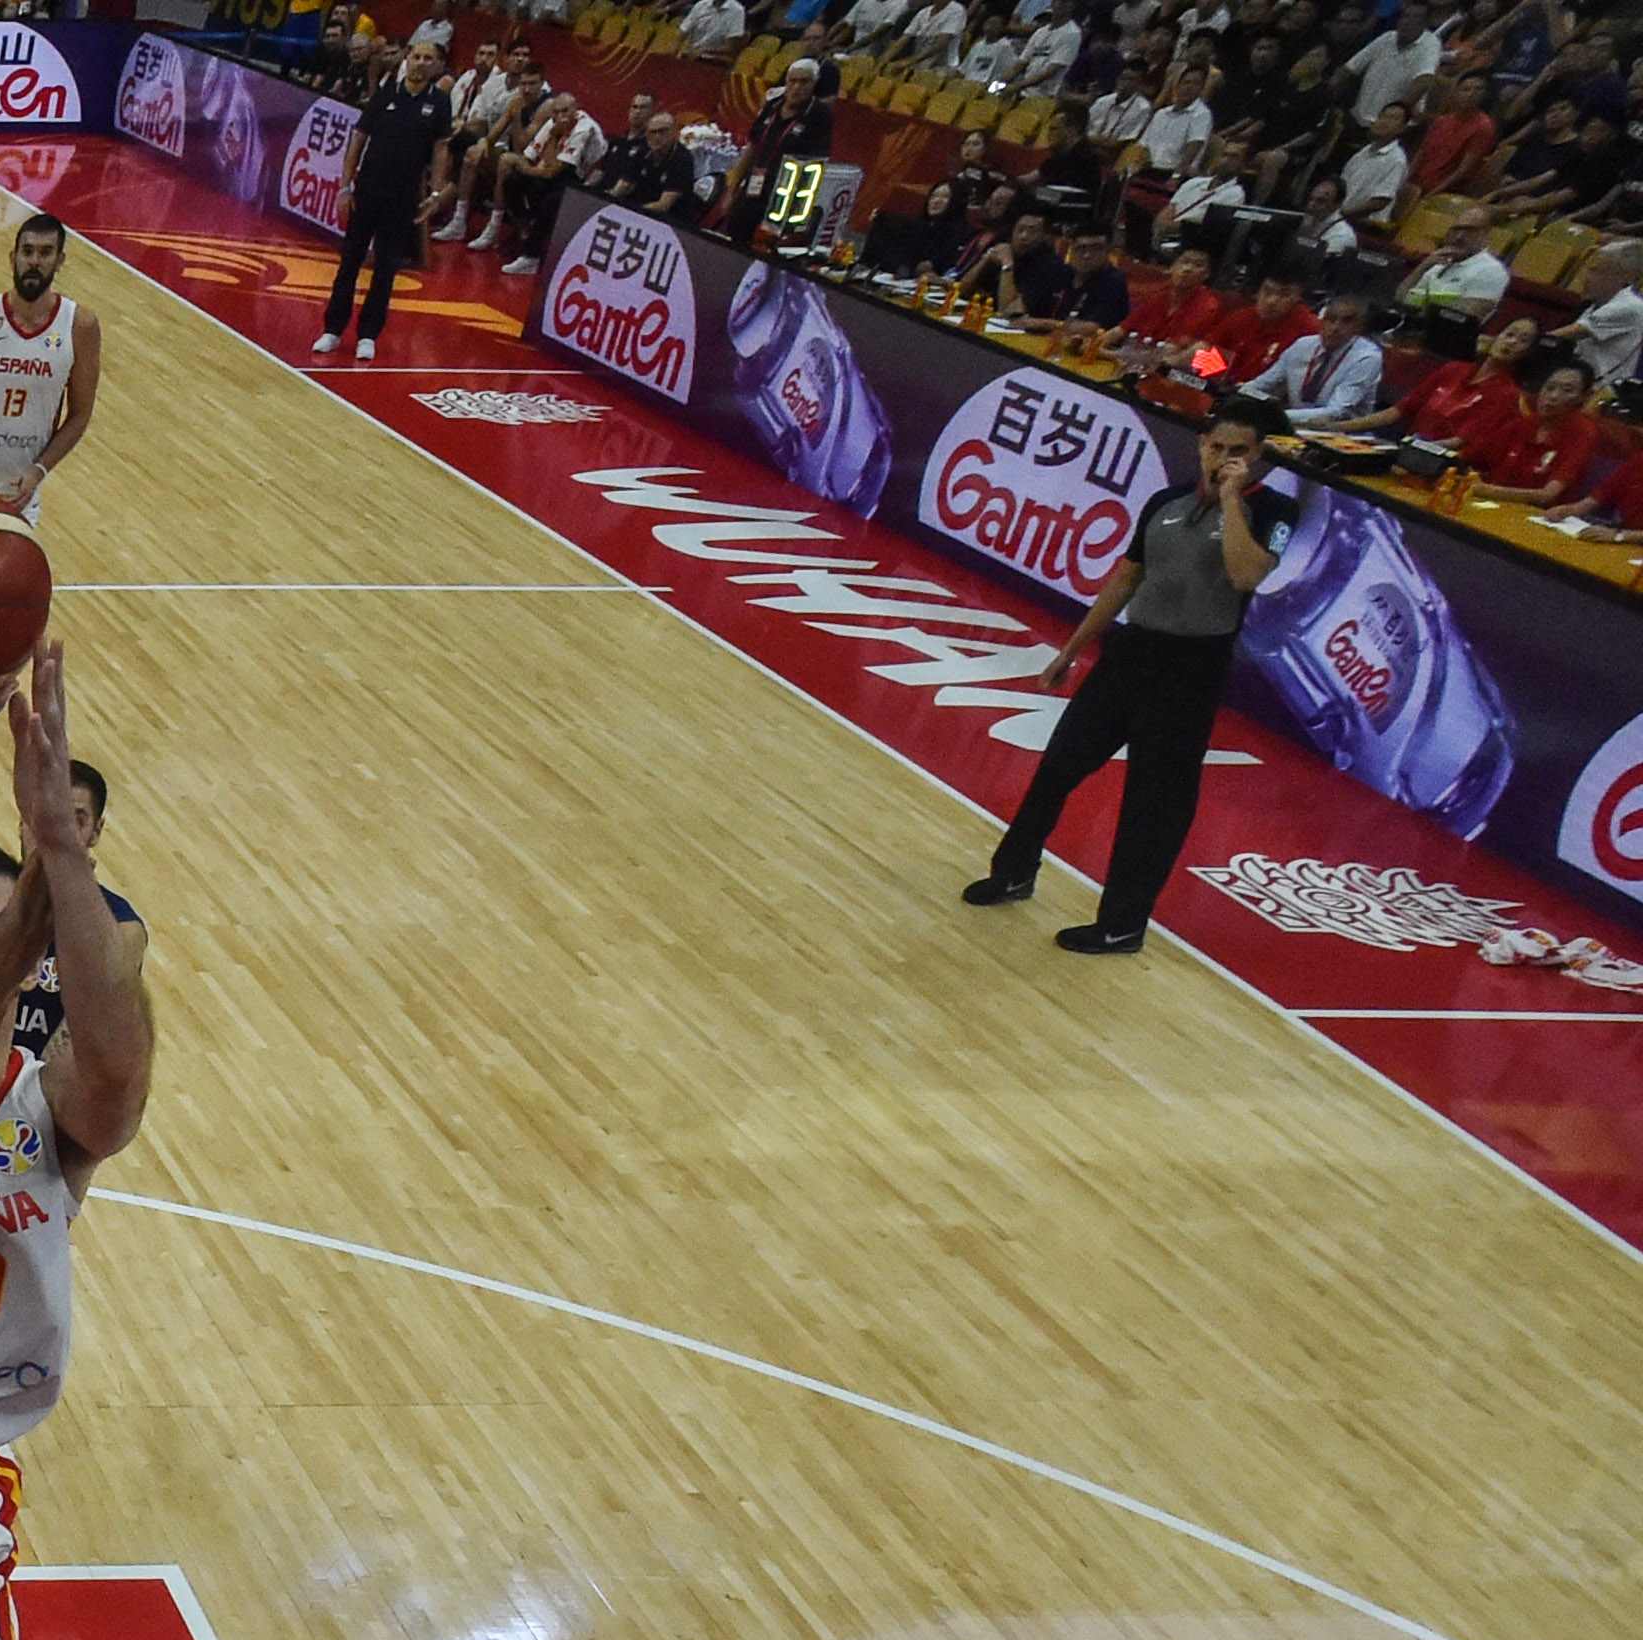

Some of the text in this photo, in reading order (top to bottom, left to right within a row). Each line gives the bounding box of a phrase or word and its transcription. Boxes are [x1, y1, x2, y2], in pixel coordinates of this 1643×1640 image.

[307, 106, 352, 157] 百岁
[768, 161, 823, 223] 33
[585, 215, 680, 297] 百岁山
[2, 388, 28, 417] 13
[988, 380, 1149, 498] 百岁山
[937, 438, 1132, 597] Gante
